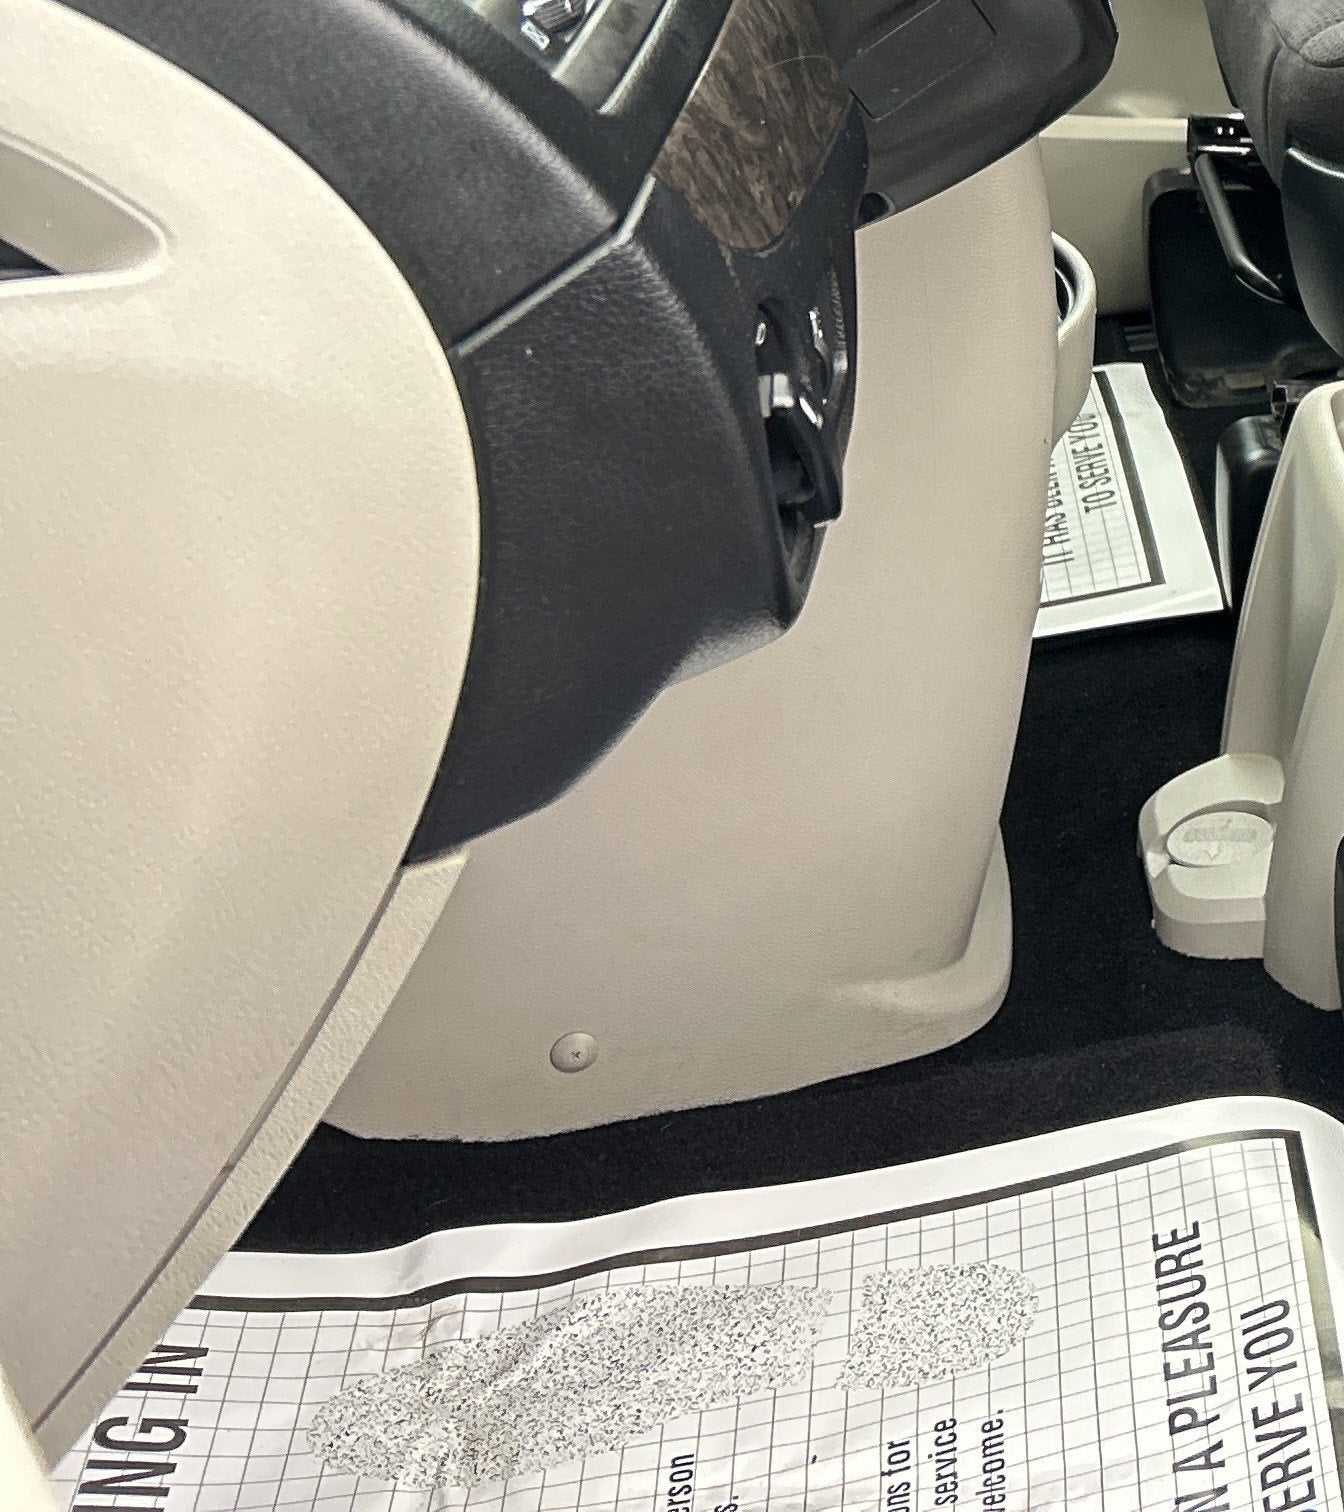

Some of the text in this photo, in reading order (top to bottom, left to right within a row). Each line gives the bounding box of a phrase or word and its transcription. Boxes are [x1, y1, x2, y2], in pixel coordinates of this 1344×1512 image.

[1071, 442, 1112, 489] SERVE
[1081, 489, 1118, 514] TO
[1151, 1220, 1221, 1436] PLEASURE
[121, 1344, 209, 1394] IN
[1240, 1298, 1317, 1512] ERVE YOU
[880, 1439, 911, 1476] for
[927, 1417, 958, 1506] service
[975, 1409, 1006, 1512] elcome.
[1172, 1439, 1226, 1473] A
